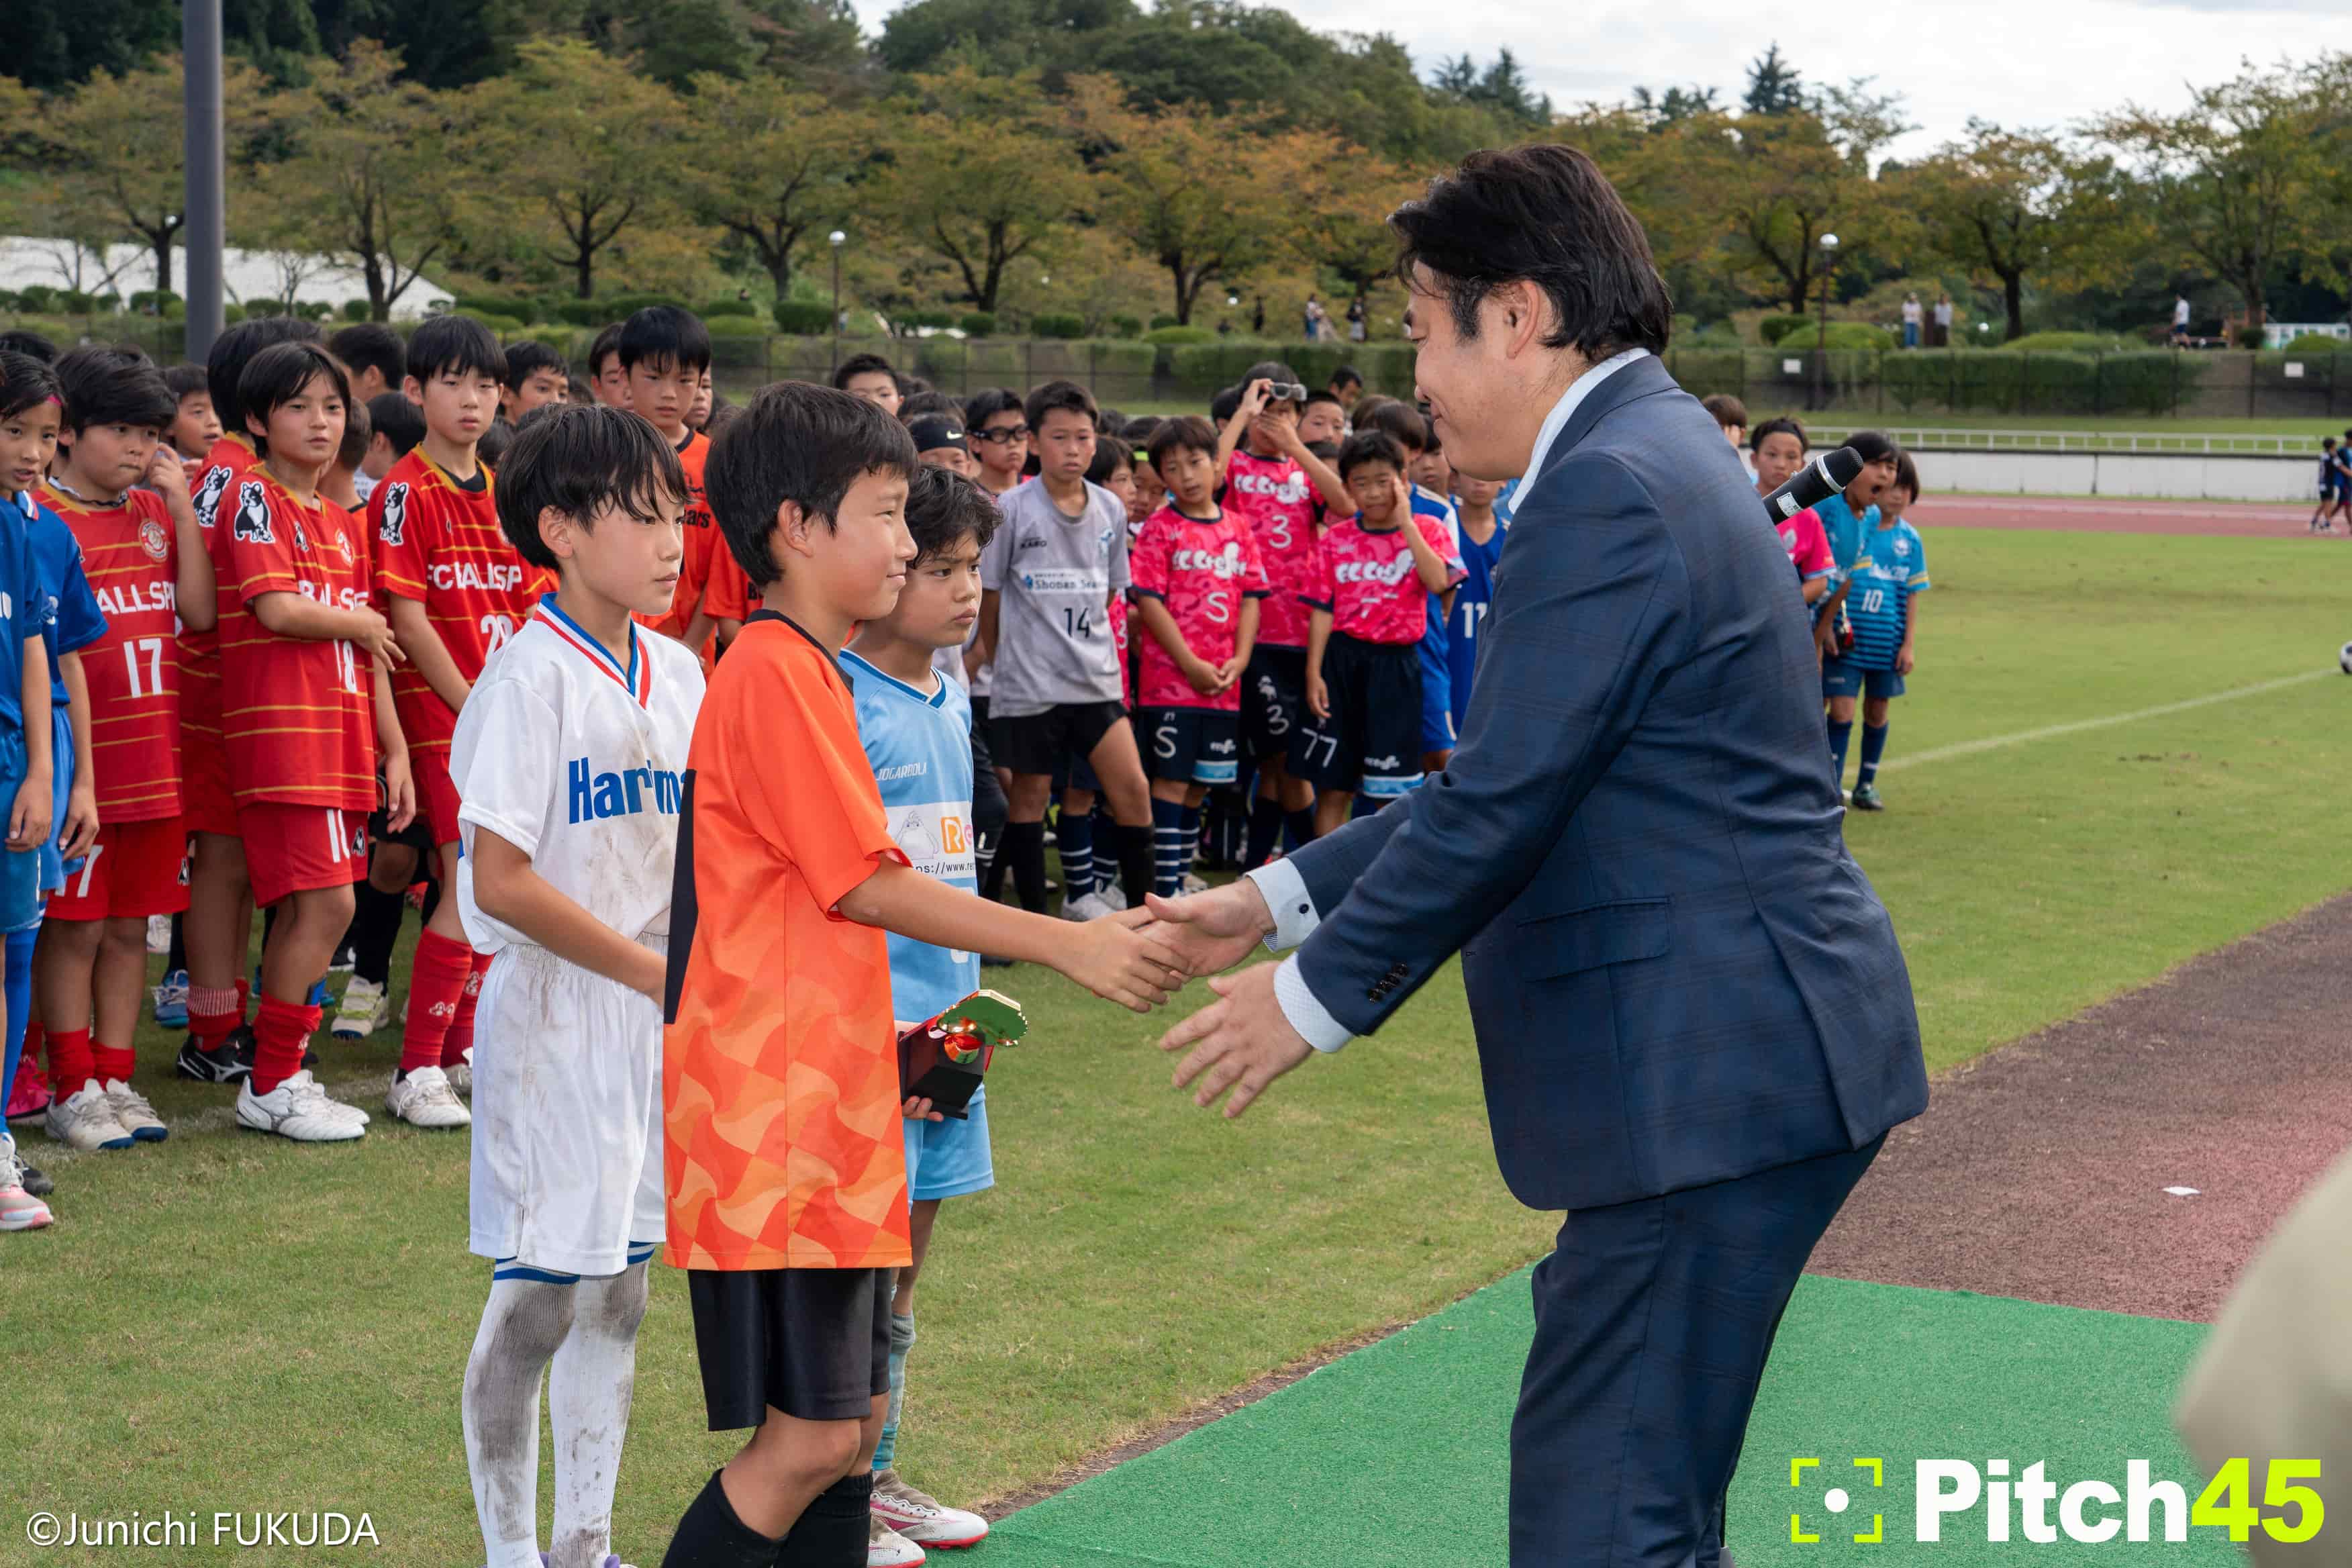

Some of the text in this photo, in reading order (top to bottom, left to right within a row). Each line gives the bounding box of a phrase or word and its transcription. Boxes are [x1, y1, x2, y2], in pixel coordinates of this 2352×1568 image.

[1268, 514, 1293, 548] 3
[1861, 589, 1883, 613] 10
[1063, 607, 1089, 639] 14
[124, 638, 162, 698] 17
[334, 638, 358, 694] 18
[1267, 704, 1289, 734] 3
[1302, 728, 1337, 767] 77
[54, 844, 103, 897] 7
